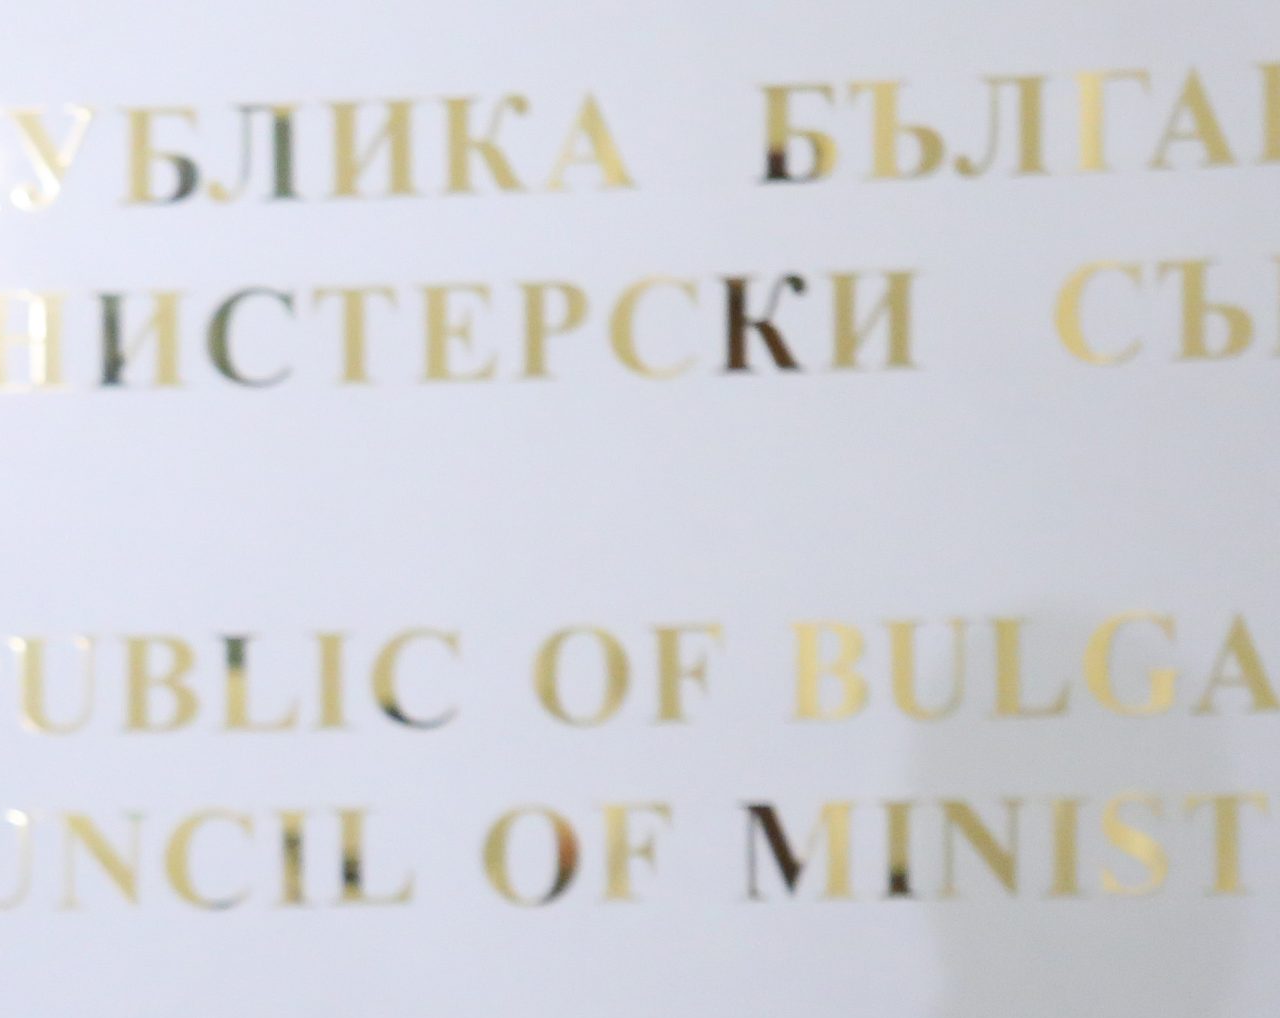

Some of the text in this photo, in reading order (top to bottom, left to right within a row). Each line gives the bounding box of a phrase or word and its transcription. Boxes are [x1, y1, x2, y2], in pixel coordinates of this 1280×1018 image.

[1053, 254, 1280, 365] СЪ
[531, 622, 724, 728] OF
[790, 610, 1280, 722] BULGA
[482, 802, 673, 907] OF
[742, 791, 1271, 902] MINIST
